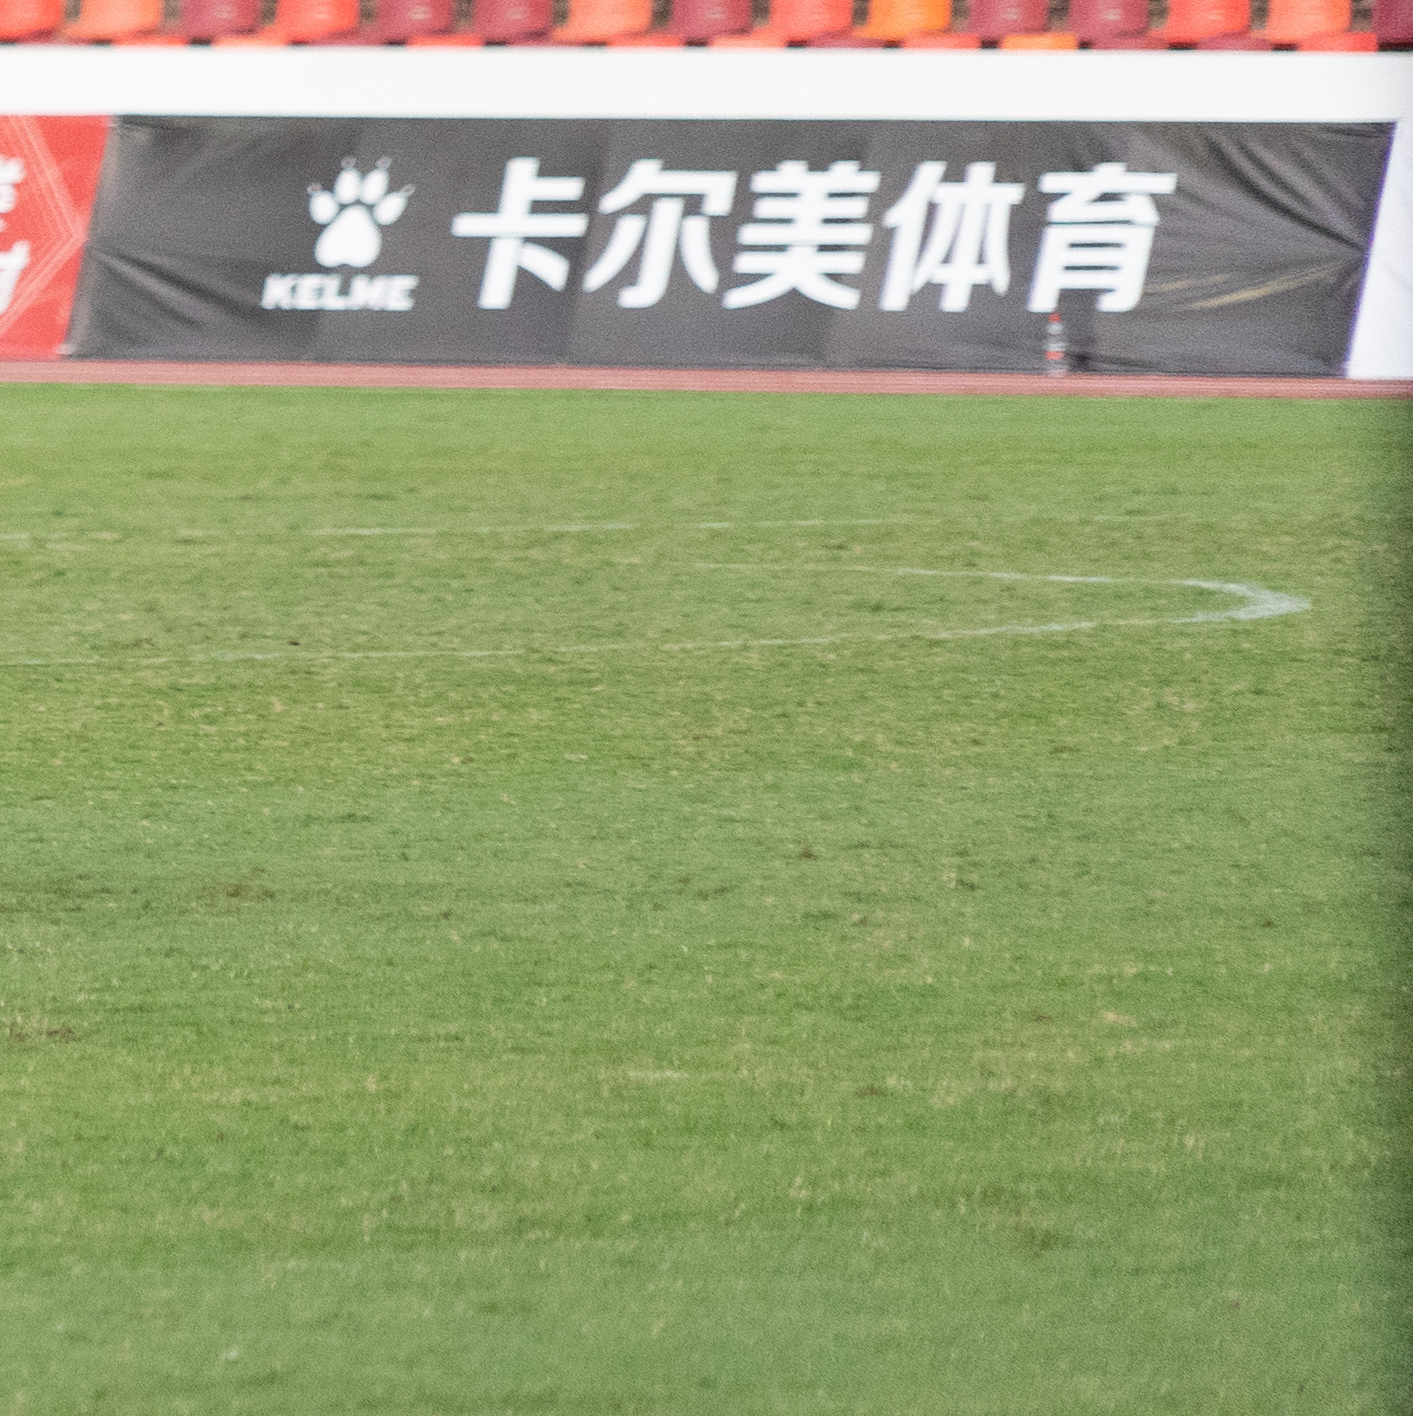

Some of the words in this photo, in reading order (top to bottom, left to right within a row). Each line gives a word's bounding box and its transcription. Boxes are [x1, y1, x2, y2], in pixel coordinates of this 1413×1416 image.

[450, 156, 1179, 313] 卡尔美体育
[261, 272, 420, 311] KELME
